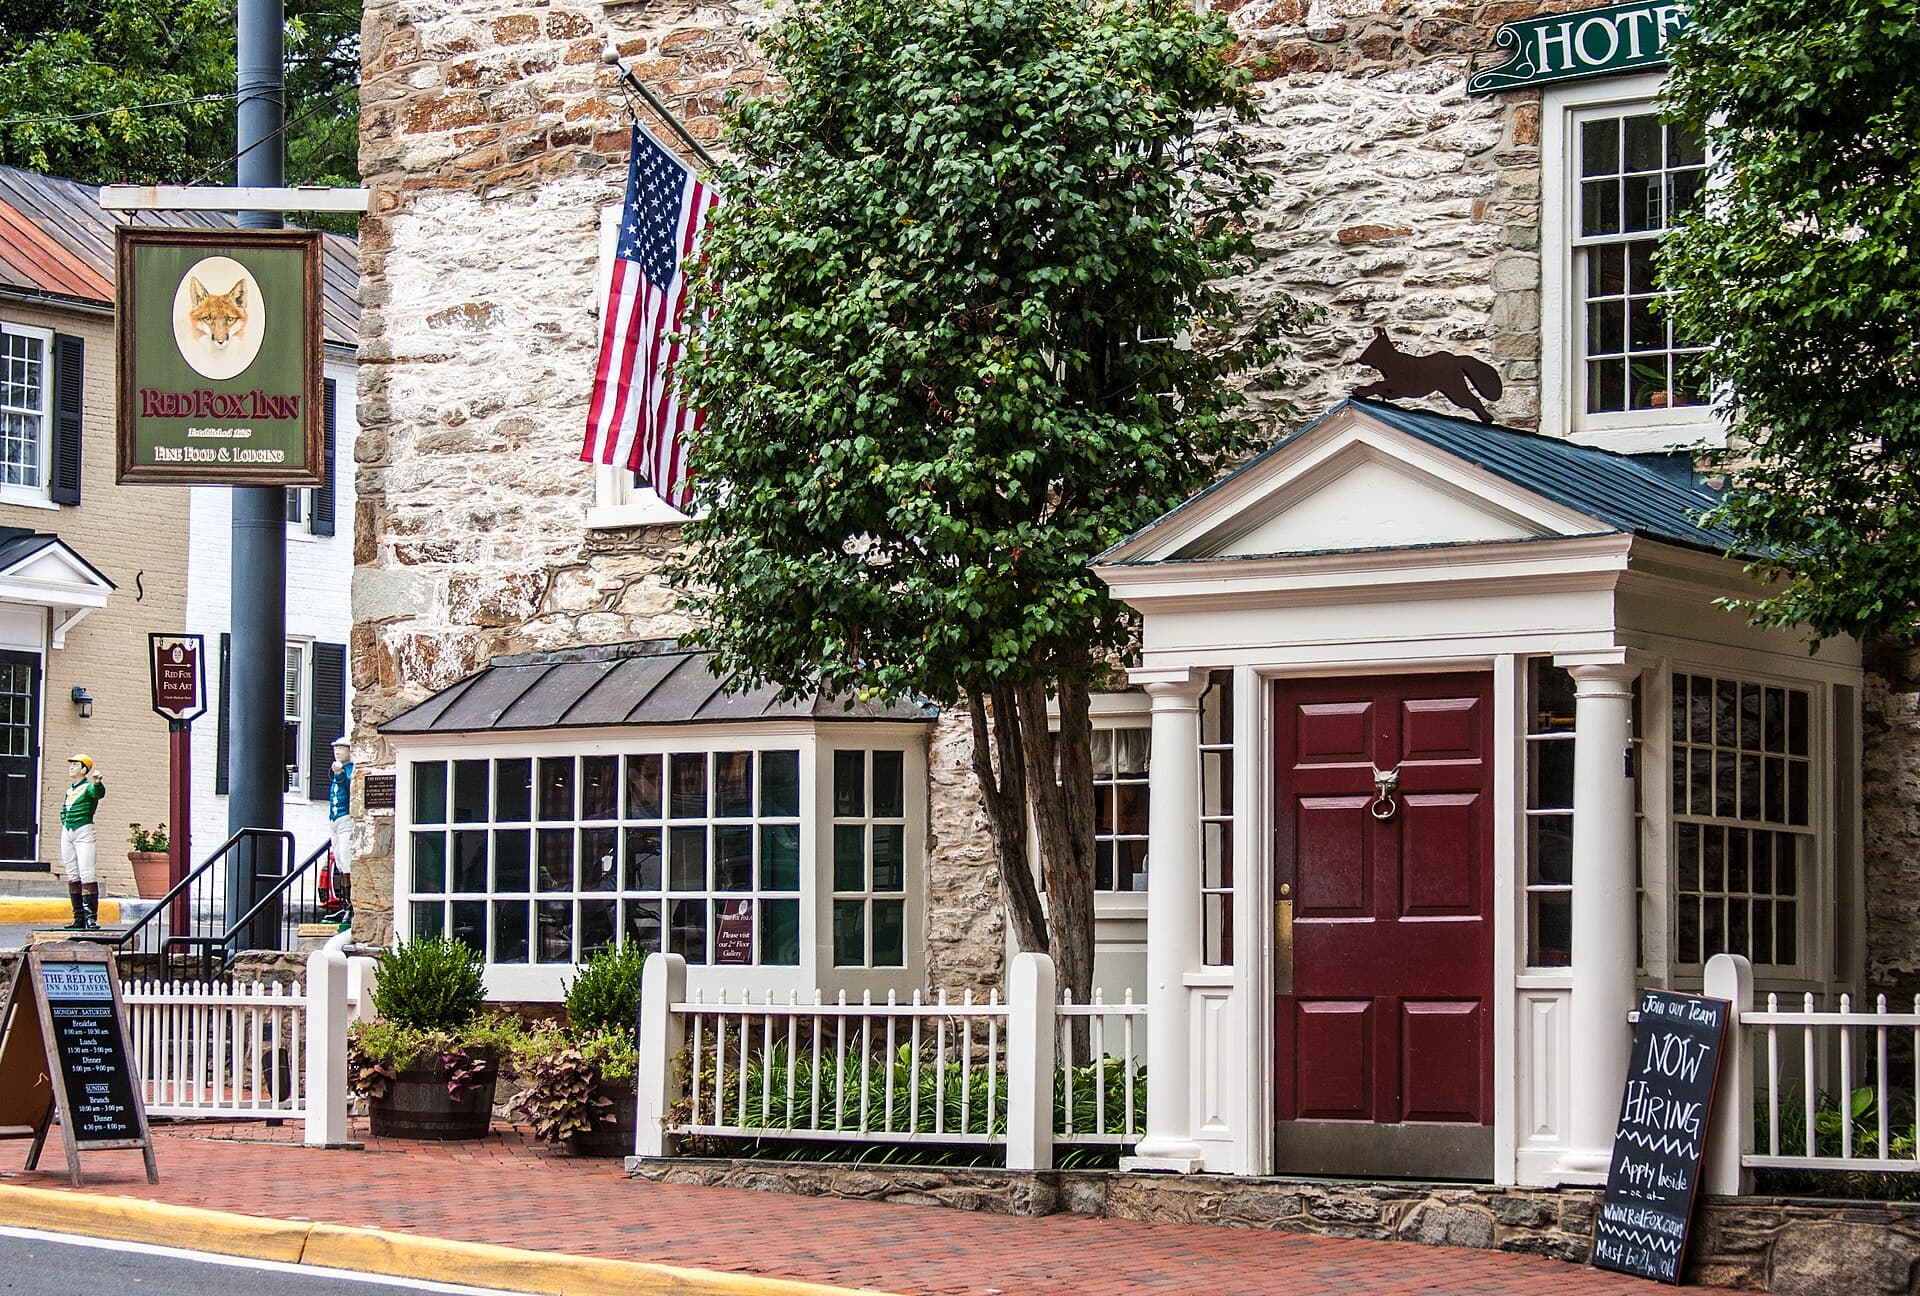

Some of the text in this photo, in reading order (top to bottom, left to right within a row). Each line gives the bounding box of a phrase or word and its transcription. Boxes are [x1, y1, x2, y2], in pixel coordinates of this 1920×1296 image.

[1534, 4, 1688, 74] HOTE
[141, 388, 300, 420] RED FOX INN
[154, 446, 284, 463] FINE FOOD & LODGING
[164, 682, 178, 690] FINE
[165, 670, 191, 678] RED FOX
[43, 974, 107, 983] THE RED FOX
[1642, 995, 1716, 1027] Join our Team
[1643, 1032, 1710, 1084] NOW
[1620, 1156, 1687, 1190] Apply Inside
[1596, 1240, 1624, 1264] Must
[1661, 1258, 1675, 1278] old
